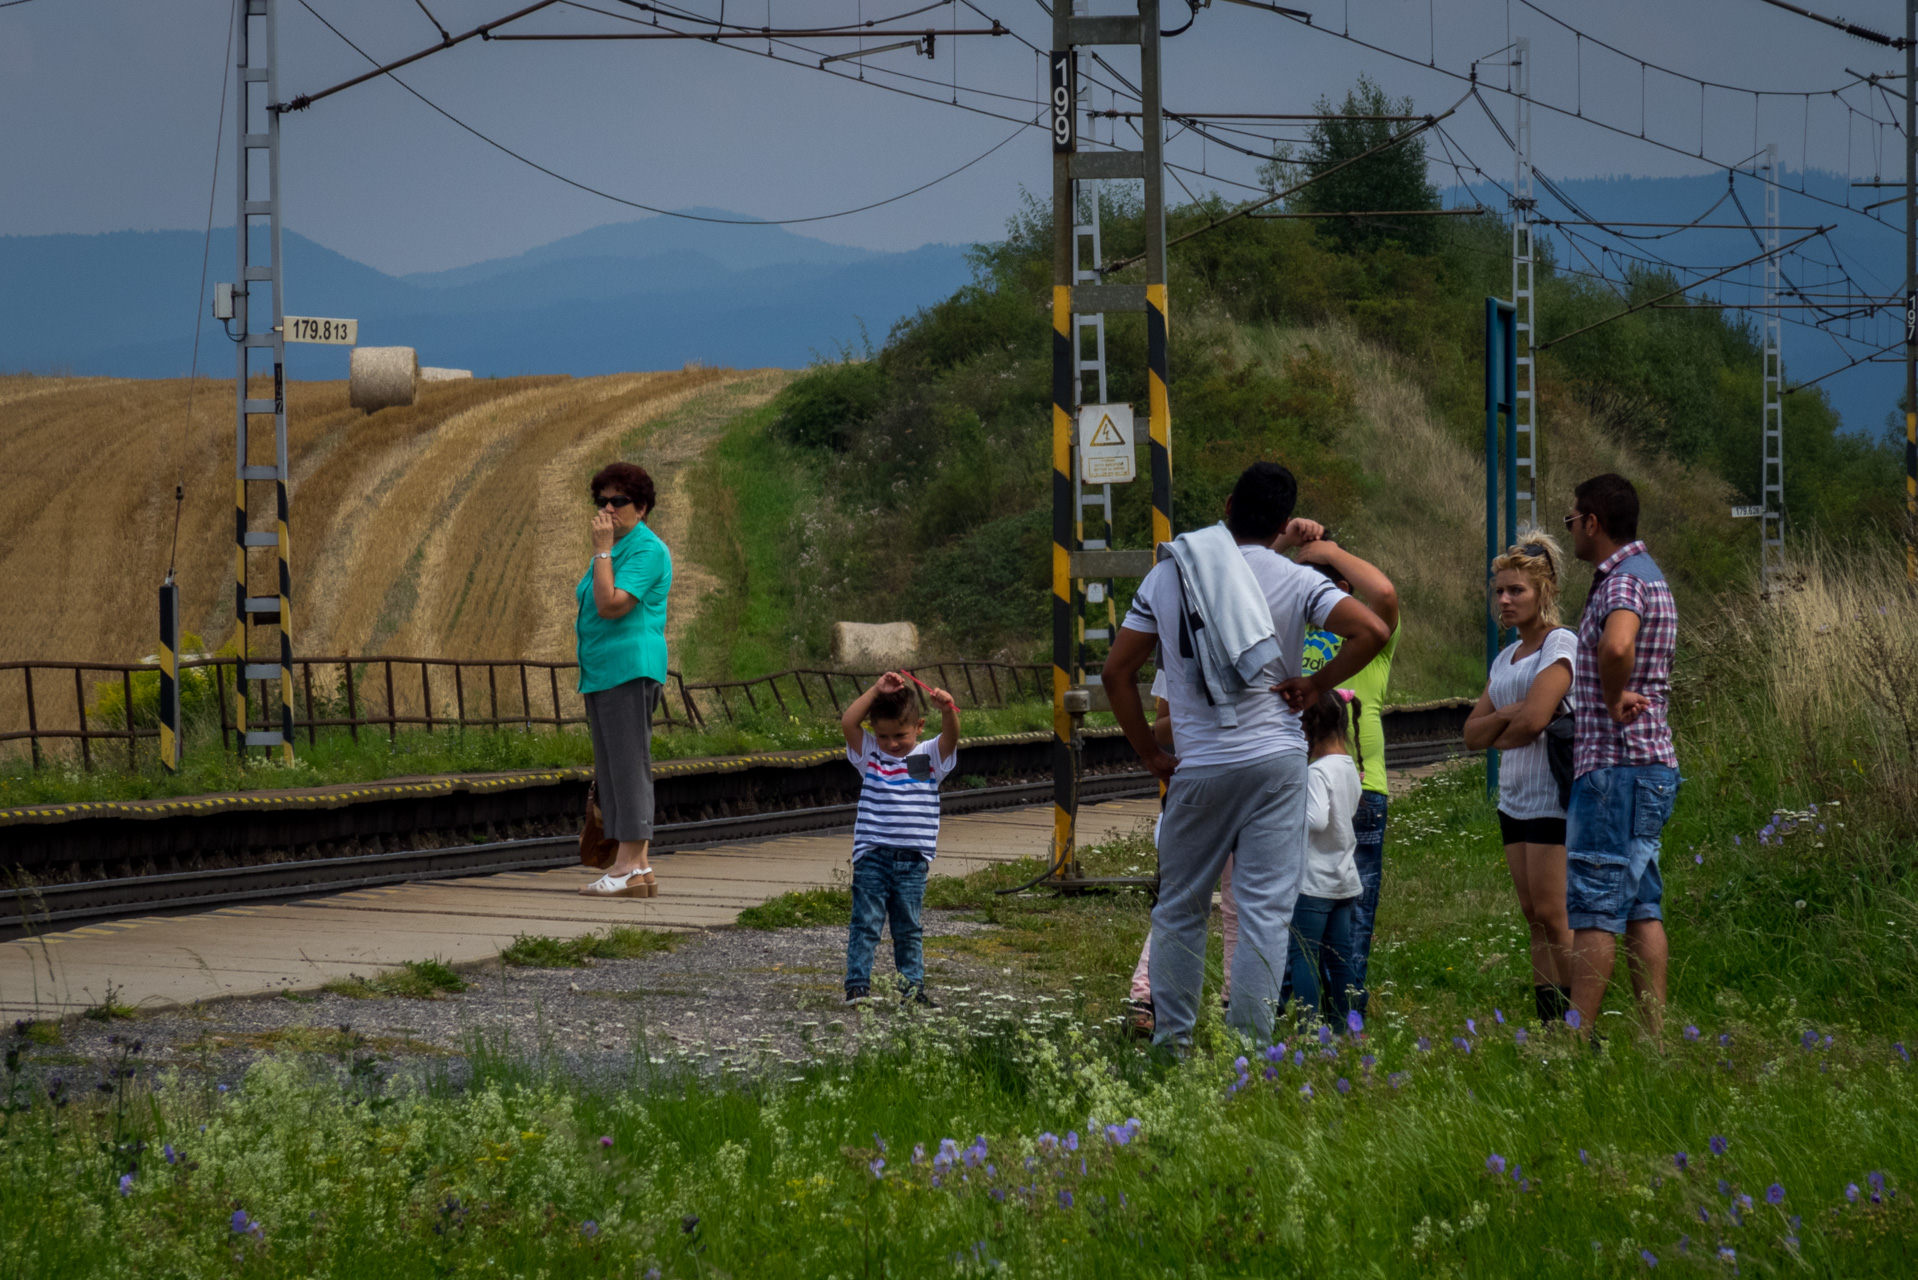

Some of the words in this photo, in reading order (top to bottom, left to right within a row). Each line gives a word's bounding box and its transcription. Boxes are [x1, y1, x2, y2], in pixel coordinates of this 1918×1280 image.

[1054, 58, 1070, 145] 199
[293, 319, 348, 340] 179.813
[1907, 295, 1916, 340] 197
[1302, 657, 1325, 670] adi
